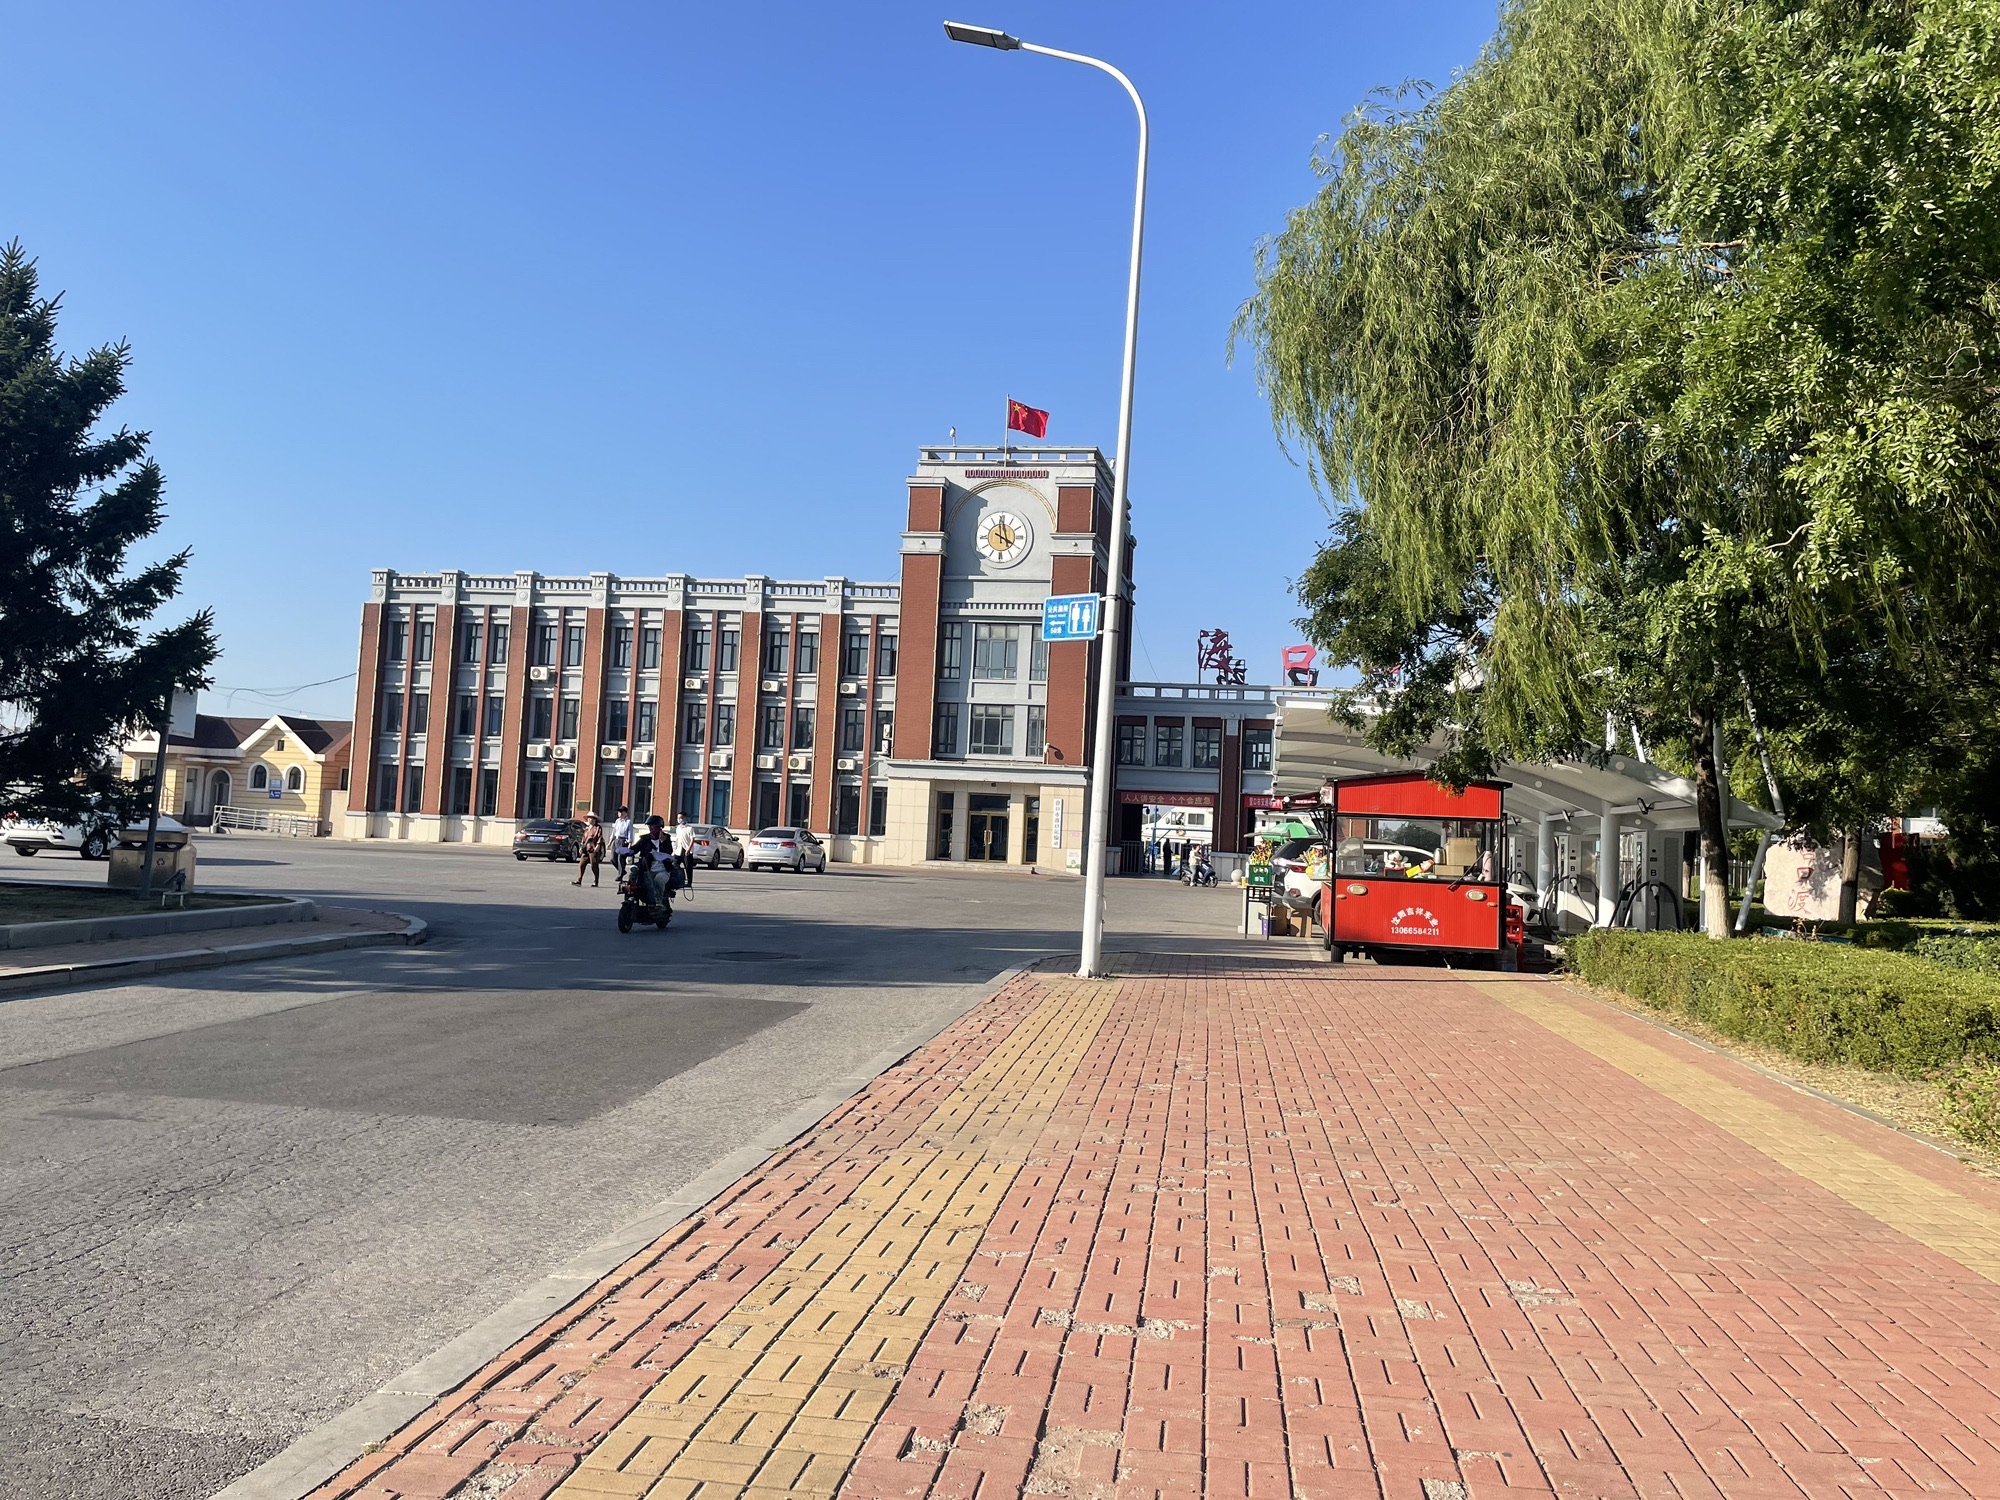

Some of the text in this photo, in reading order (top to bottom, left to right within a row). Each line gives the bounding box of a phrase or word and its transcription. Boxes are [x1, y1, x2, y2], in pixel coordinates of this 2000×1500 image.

[1124, 794, 1212, 805] 人人讲安全 个个会应急
[1391, 927, 1439, 936] 13066584211
